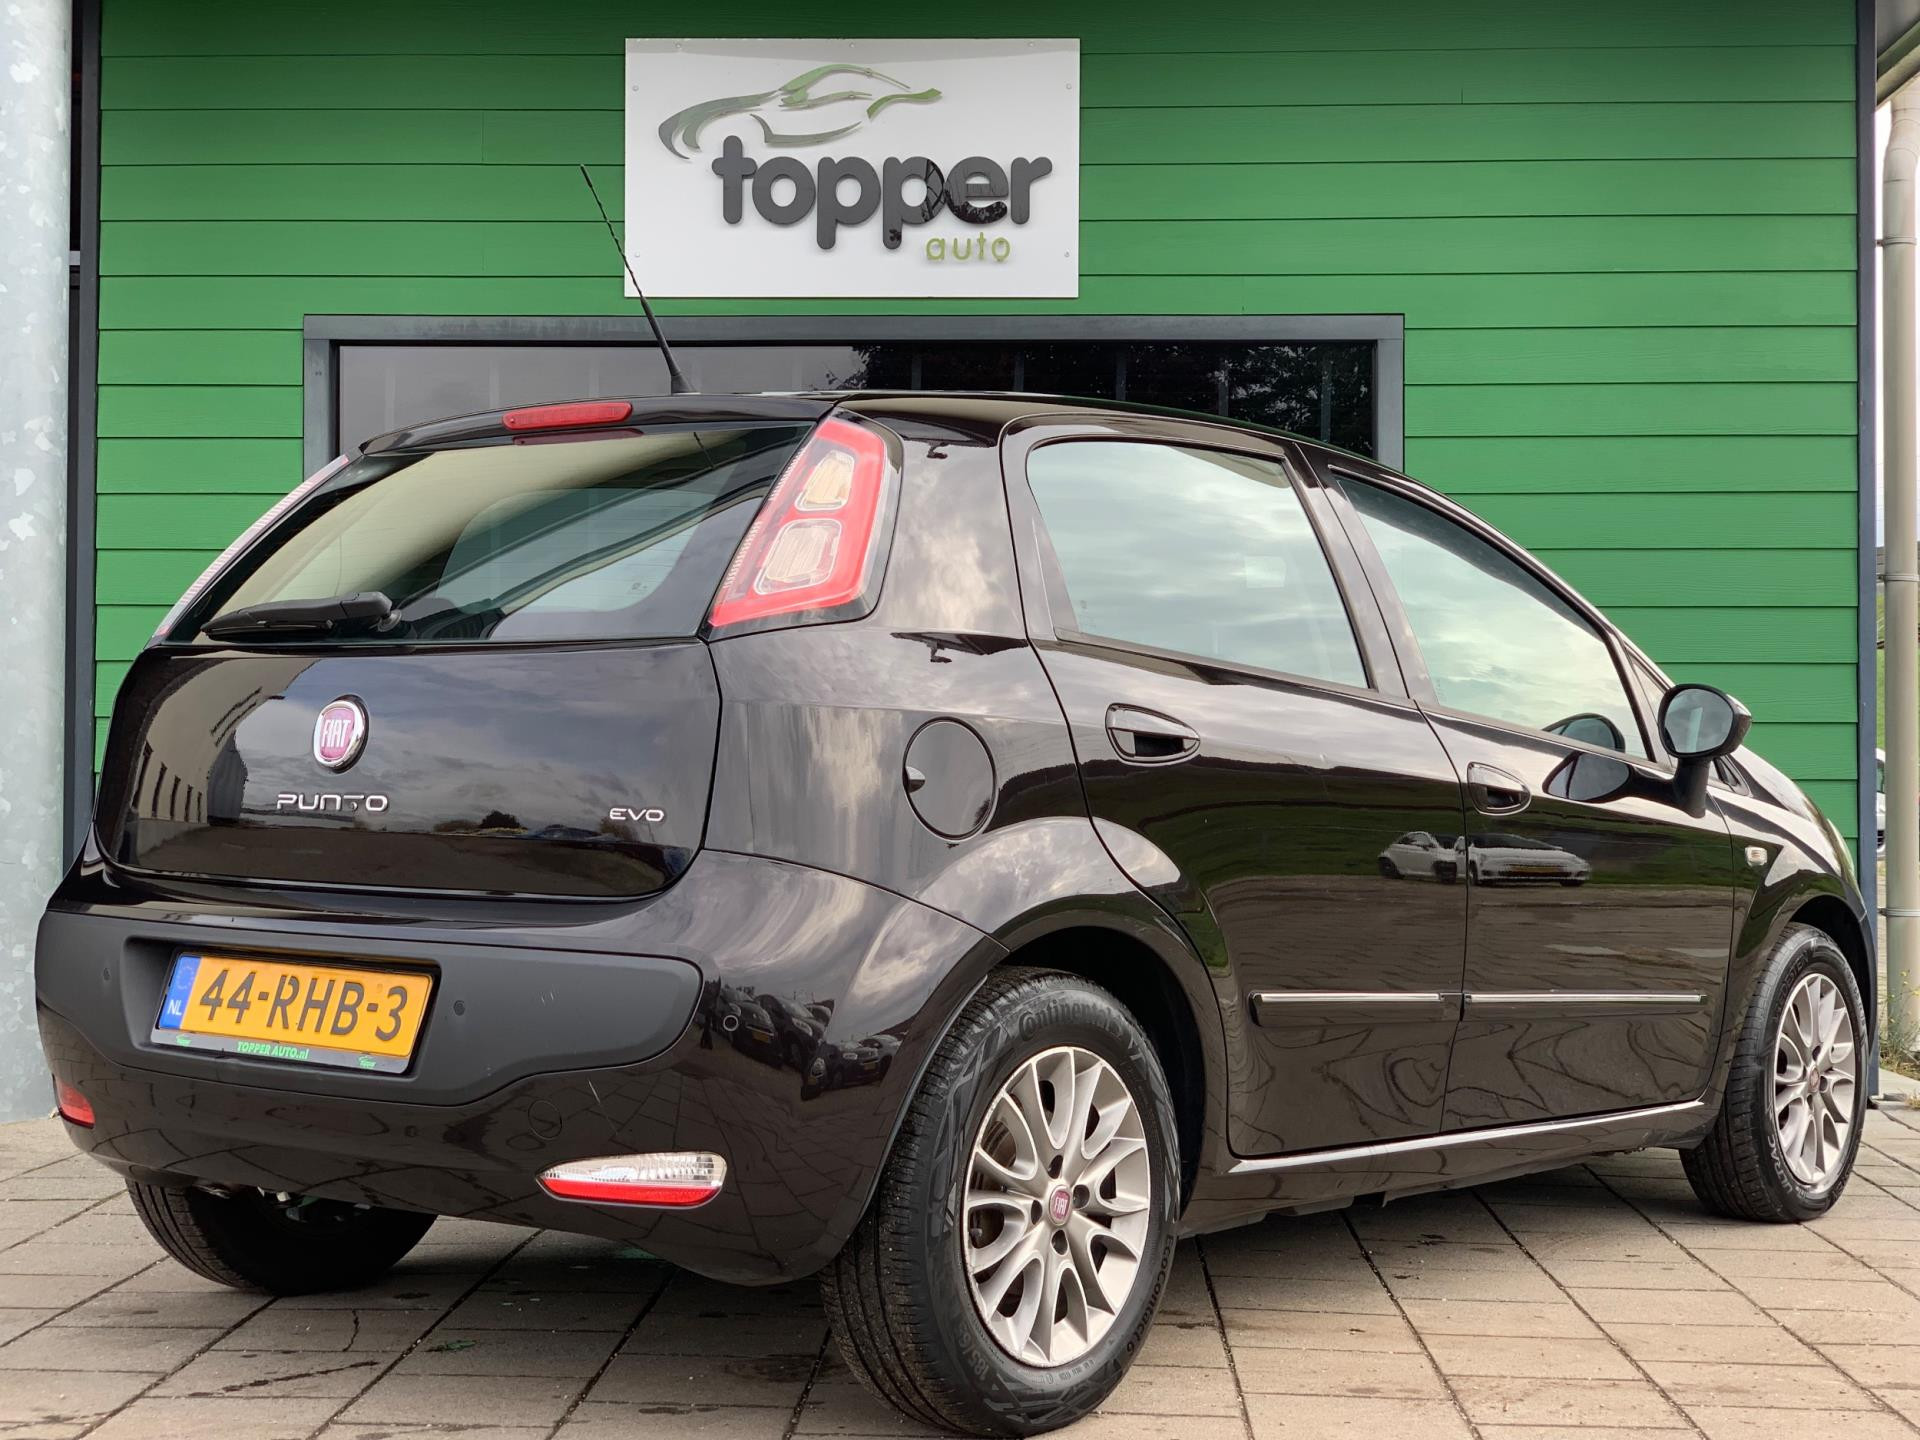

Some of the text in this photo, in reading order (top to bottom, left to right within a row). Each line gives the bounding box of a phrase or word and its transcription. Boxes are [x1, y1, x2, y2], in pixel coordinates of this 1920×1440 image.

[711, 135, 1053, 249] topper
[926, 231, 1011, 262] auto
[321, 718, 352, 749] FIAT
[276, 793, 389, 813] PUNTO
[609, 806, 665, 823] EVO
[167, 999, 183, 1017] NL
[200, 968, 408, 1041] 44-RHB-3
[1018, 999, 1112, 1041] Continental
[236, 1040, 309, 1060] TOPPER AUTO.nl
[1055, 1196, 1069, 1216] FIAT
